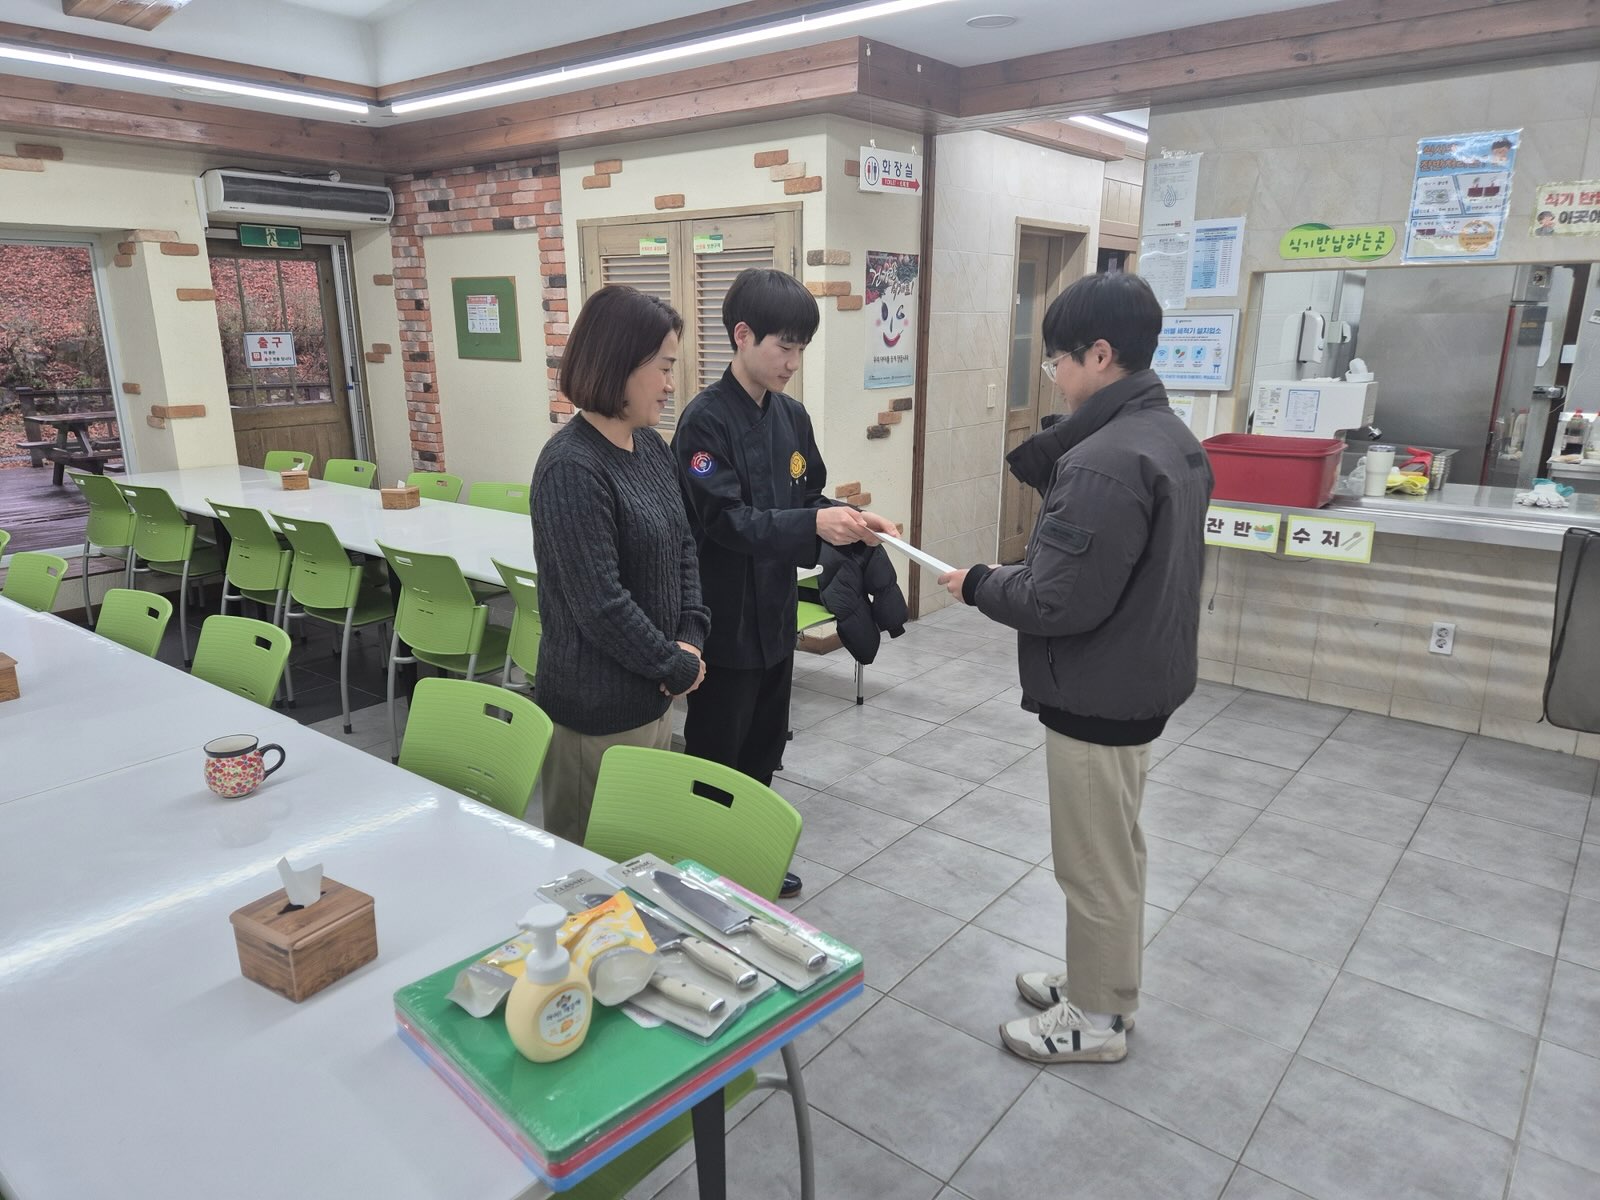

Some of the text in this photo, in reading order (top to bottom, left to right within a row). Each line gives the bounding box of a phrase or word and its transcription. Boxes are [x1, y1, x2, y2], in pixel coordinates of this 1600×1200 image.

[882, 159, 913, 178] 화장실
[1545, 191, 1574, 207] 식기
[257, 336, 282, 348] 출구
